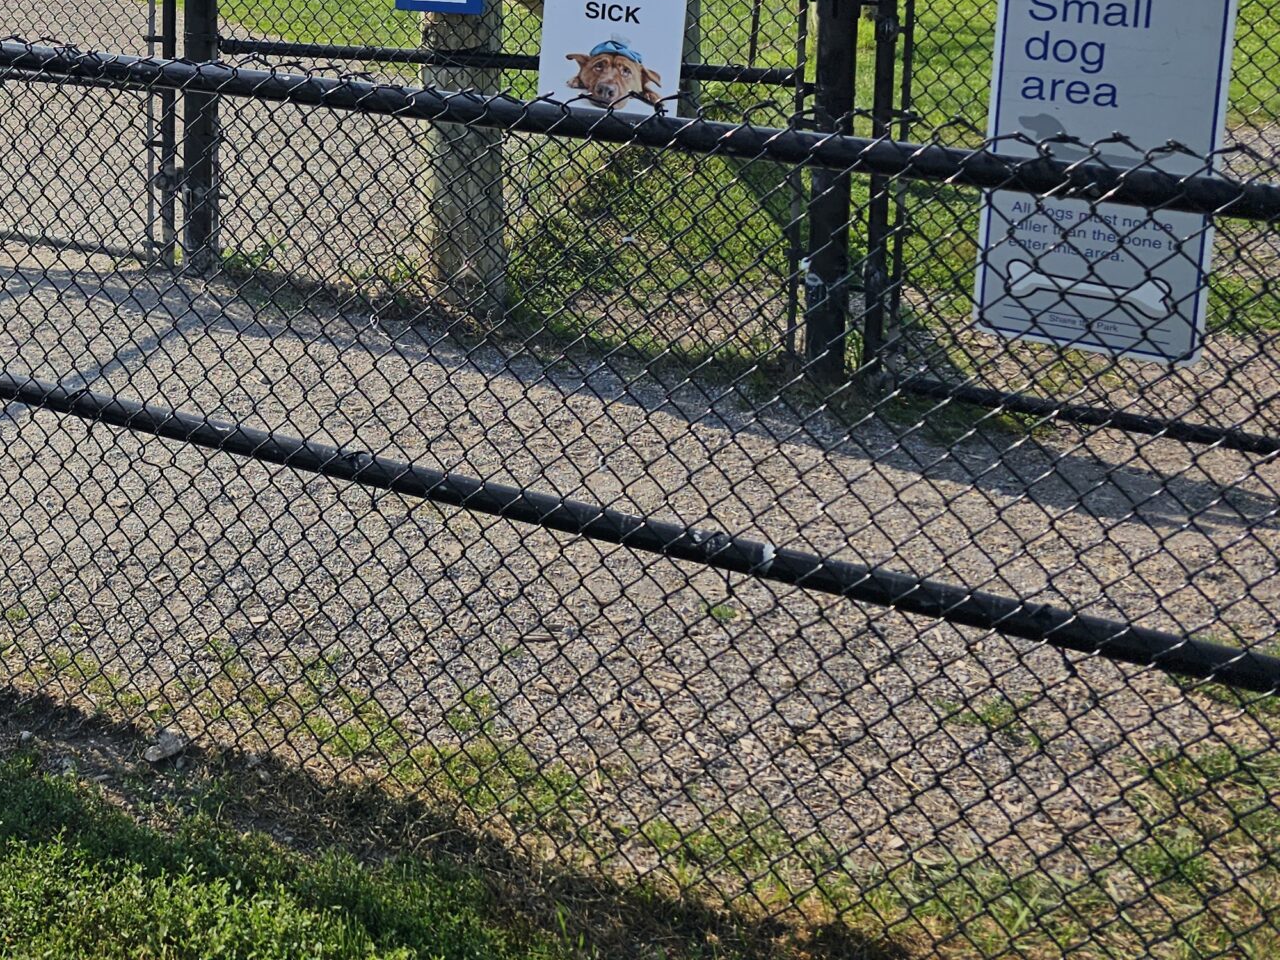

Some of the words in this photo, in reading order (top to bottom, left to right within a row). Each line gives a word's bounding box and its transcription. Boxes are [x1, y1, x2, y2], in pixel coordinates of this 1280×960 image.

[585, 1, 642, 25] SICK
[1024, 30, 1106, 74] dog
[1020, 76, 1119, 109] area
[1011, 201, 1031, 214] All
[1092, 229, 1116, 243] the
[1096, 321, 1119, 333] Park
